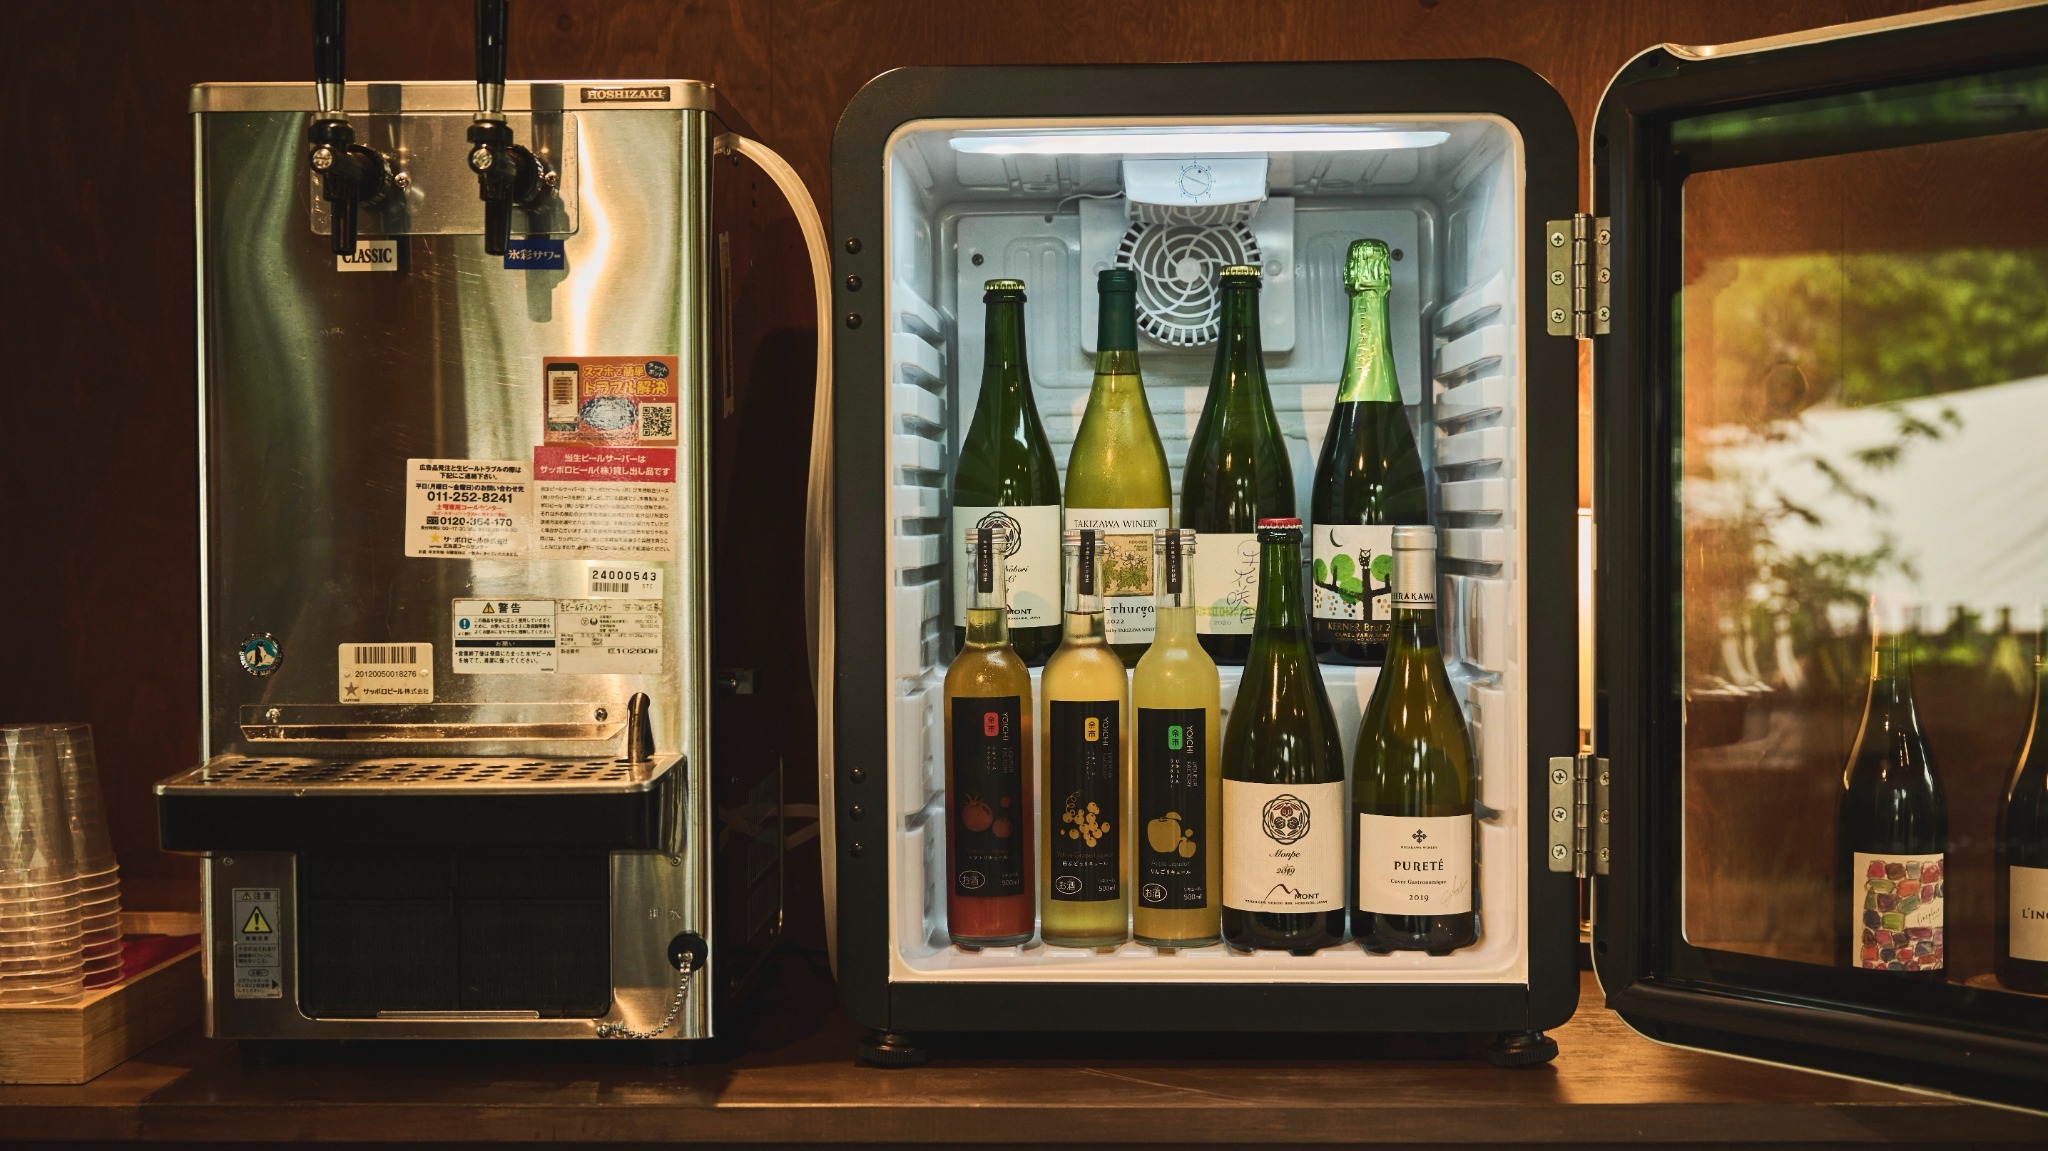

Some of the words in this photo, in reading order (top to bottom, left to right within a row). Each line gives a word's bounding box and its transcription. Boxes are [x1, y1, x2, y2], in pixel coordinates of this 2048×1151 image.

[587, 89, 664, 100] HOSHIZAKI
[342, 248, 392, 263] CLASSIC
[508, 249, 561, 261] 氷彩サワー
[583, 365, 645, 377] スマホで簡単
[564, 453, 647, 464] 当生ビールサーバーは
[427, 491, 513, 504] 011-252-8241
[1074, 519, 1120, 529] TAKIZAWA
[1122, 519, 1158, 529] WINERY
[592, 570, 657, 581] 24000543
[1391, 592, 1434, 601] HIRAKAWA
[498, 602, 521, 614] 警告
[560, 603, 612, 612] 生ビールディスペンサー
[1327, 622, 1361, 632] KERNER
[1364, 622, 1383, 632] Brut
[355, 670, 417, 678] 20120050018276
[363, 687, 429, 695] サッポロビール株式会社
[1186, 725, 1194, 754] YOICHI
[1269, 849, 1301, 860] Monpe
[1394, 858, 1444, 872] PURETÉ
[962, 874, 979, 886] お酒
[1059, 879, 1076, 891] お酒
[253, 891, 272, 900] 注意
[1145, 887, 1161, 899] お酒
[1294, 892, 1320, 900] MONT
[1409, 894, 1429, 902] 2019
